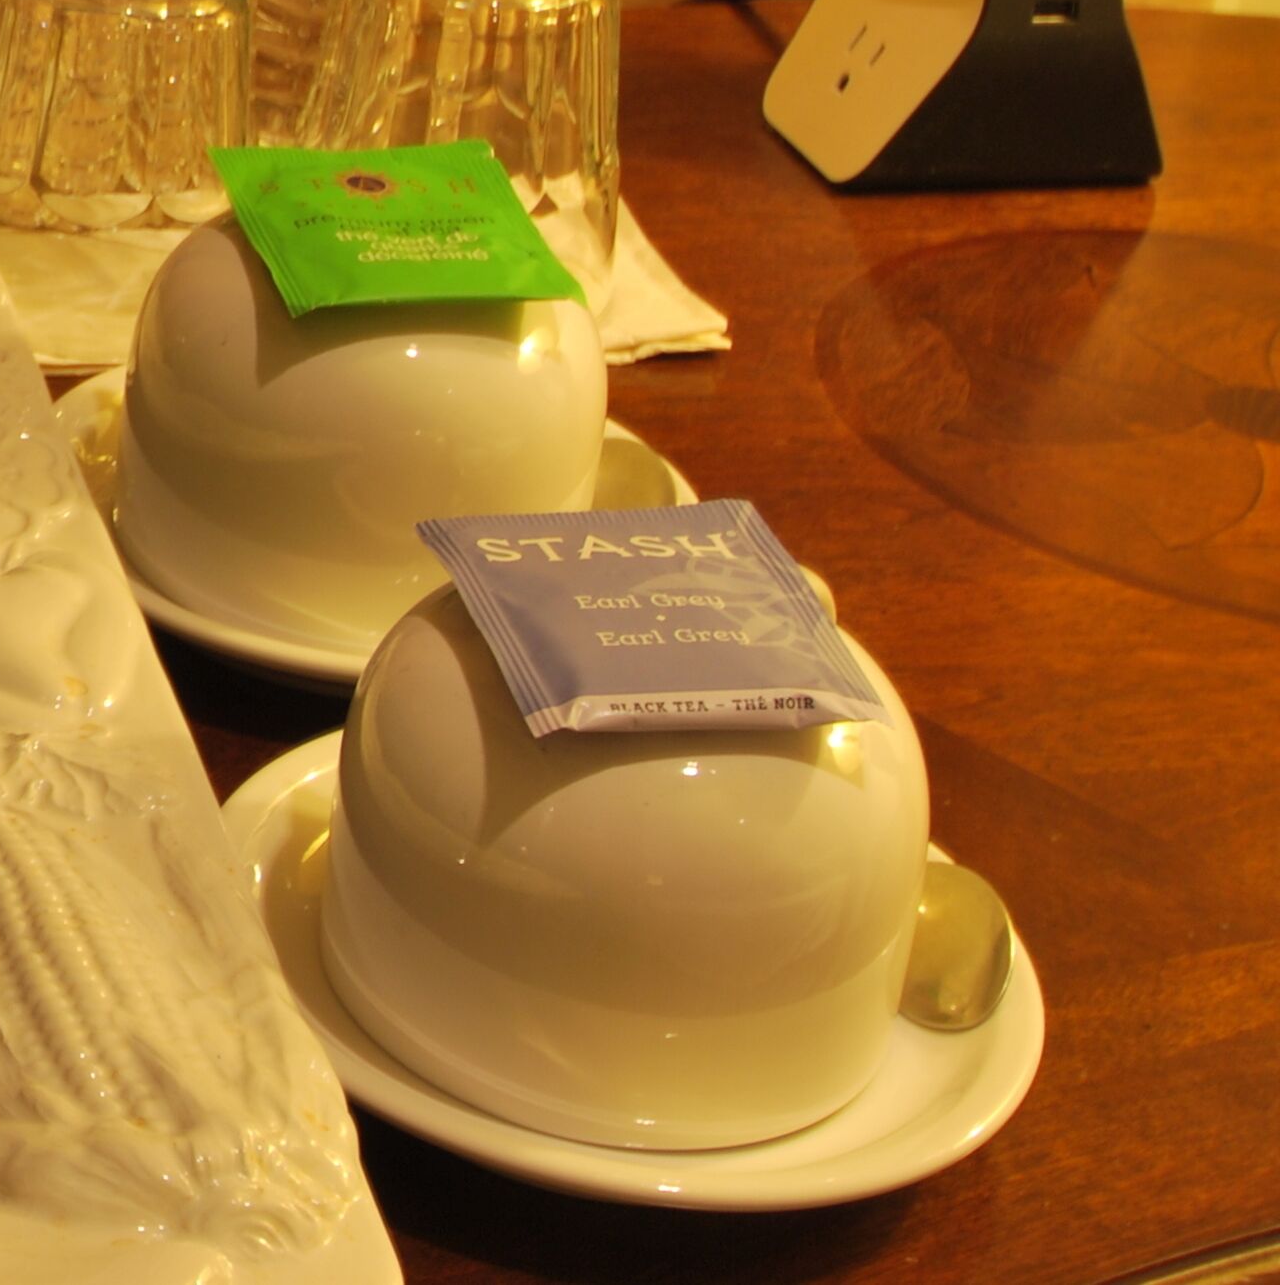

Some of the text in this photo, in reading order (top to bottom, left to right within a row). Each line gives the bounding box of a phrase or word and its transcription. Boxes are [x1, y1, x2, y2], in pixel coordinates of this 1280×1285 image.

[476, 532, 737, 563] STASH
[574, 592, 727, 612] Earl Grey
[595, 627, 750, 648] Earl Grey
[674, 699, 709, 713] TEA
[773, 696, 815, 711] NOIR
